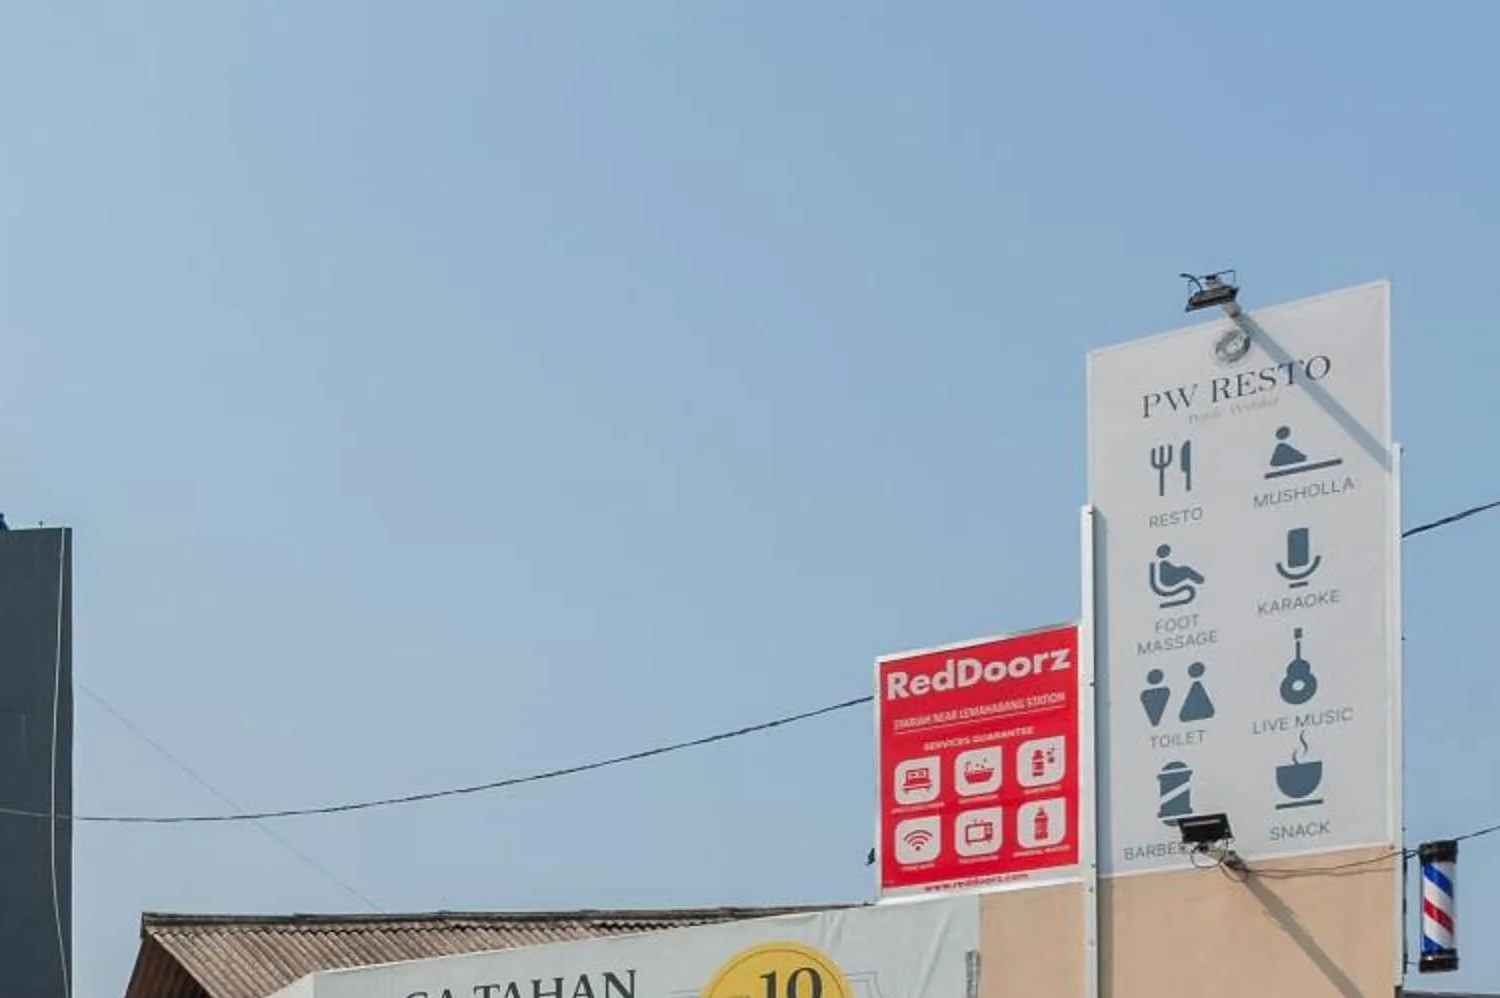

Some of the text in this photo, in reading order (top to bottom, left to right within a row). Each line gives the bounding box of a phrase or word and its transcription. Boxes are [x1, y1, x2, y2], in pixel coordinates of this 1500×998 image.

[1142, 384, 1198, 418] PW
[1211, 355, 1331, 403] RESTO
[1253, 478, 1356, 509] MUSHOLLA
[1149, 507, 1203, 529] RESTO
[1257, 589, 1341, 617] KARAOKE
[1155, 614, 1200, 634] FOOT
[1137, 630, 1219, 655] MASSAGE
[887, 648, 1071, 700] RedDoorz
[1252, 707, 1354, 735] LIVE MUSIC
[1150, 730, 1206, 750] TOILET
[1269, 820, 1331, 841] SNACK
